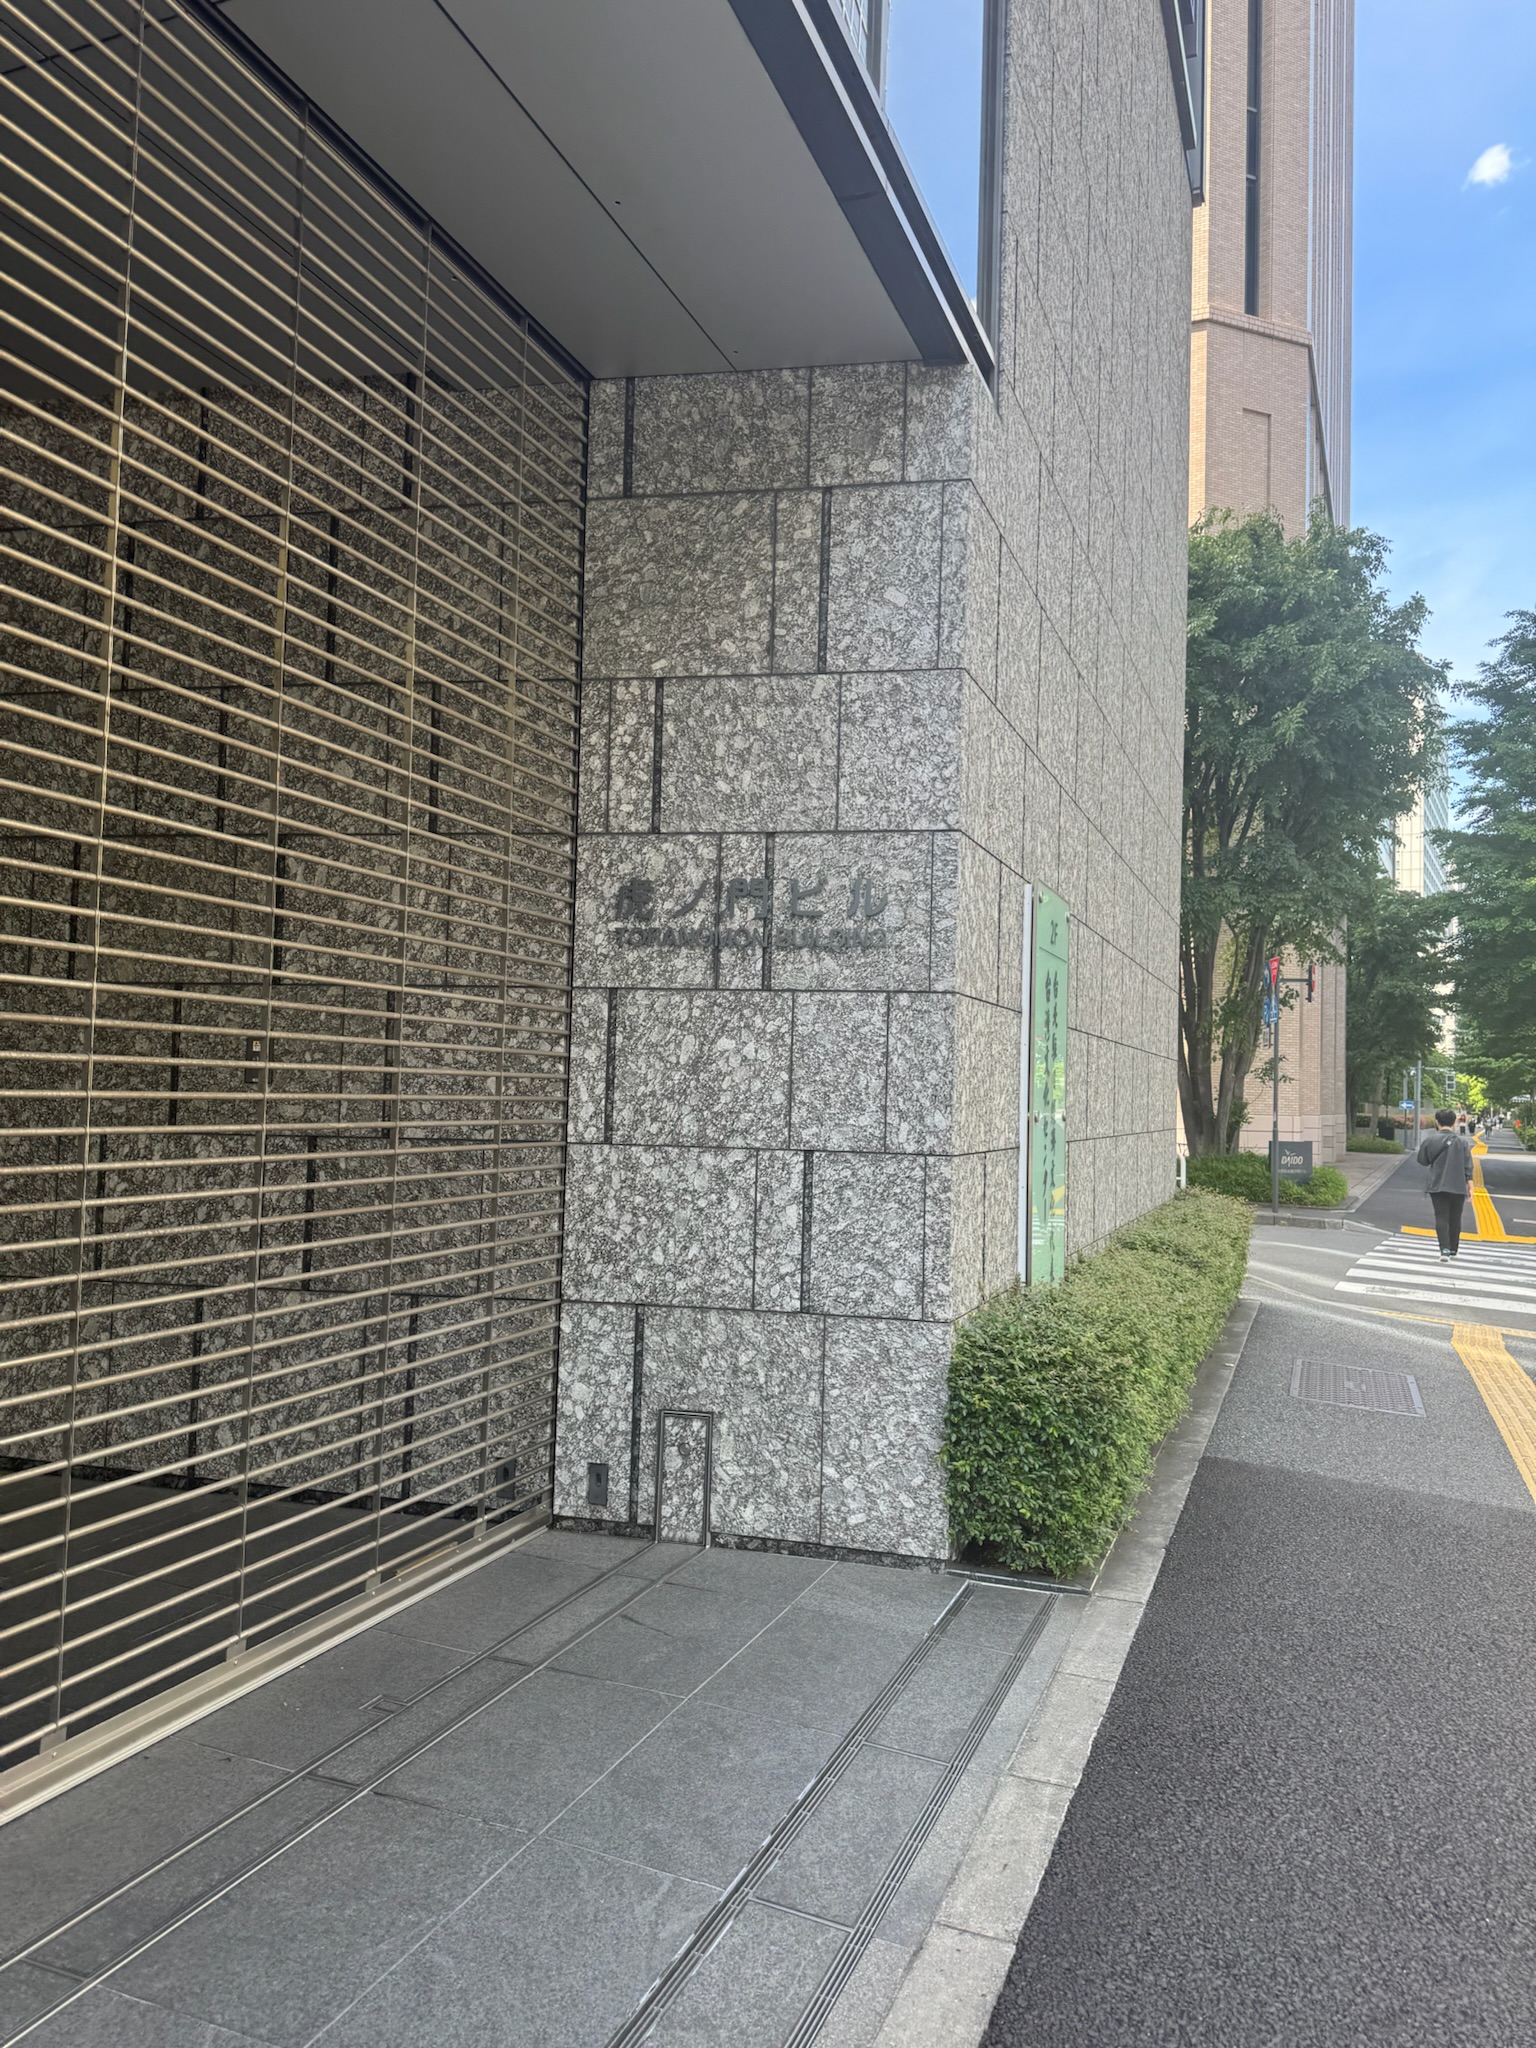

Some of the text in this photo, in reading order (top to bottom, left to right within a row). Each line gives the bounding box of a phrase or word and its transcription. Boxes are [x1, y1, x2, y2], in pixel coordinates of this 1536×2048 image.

[616, 877, 888, 919] 虎ノ門ビル
[614, 926, 887, 948] TORANOMON BUILDING
[1050, 919, 1059, 946] 2F
